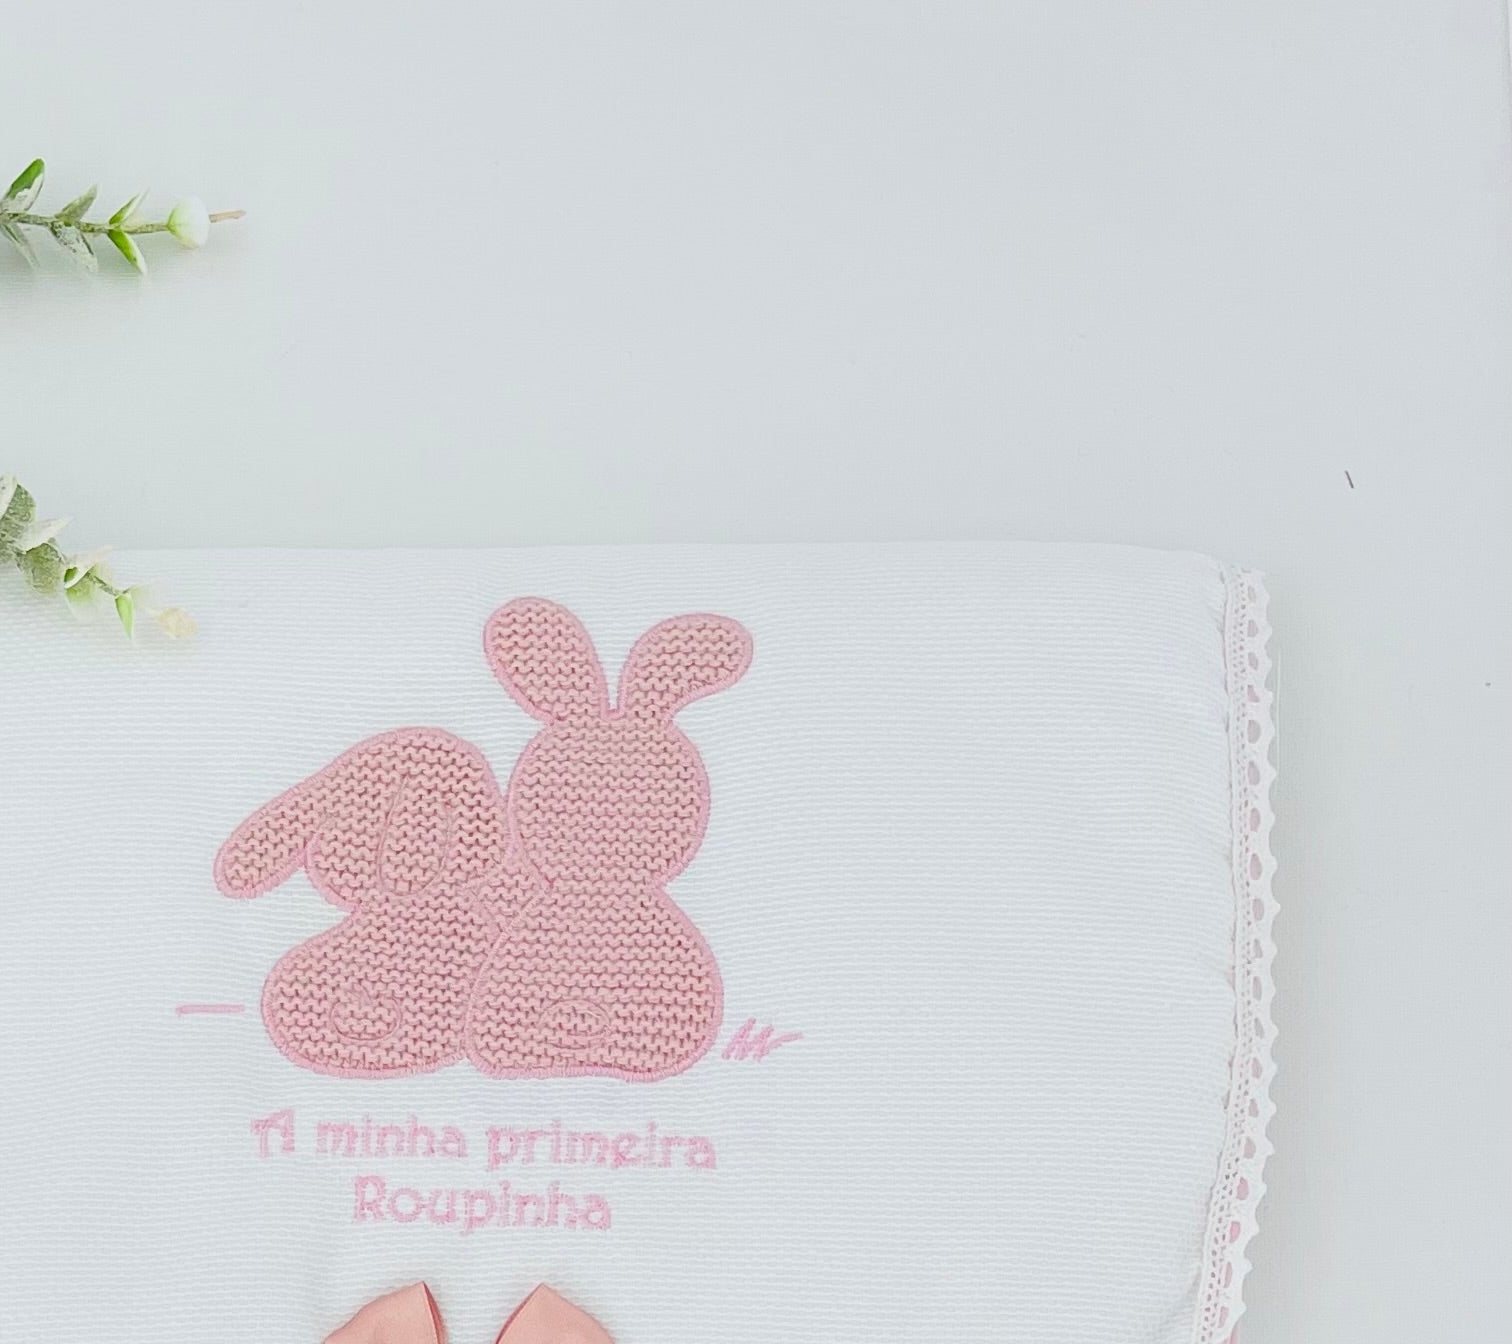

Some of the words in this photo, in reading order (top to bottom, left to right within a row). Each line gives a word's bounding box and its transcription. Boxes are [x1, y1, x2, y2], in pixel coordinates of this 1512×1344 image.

[250, 1109, 296, 1159] A
[315, 1115, 468, 1159] minha
[485, 1120, 717, 1171] primeira
[352, 1175, 612, 1236] Roupinha
